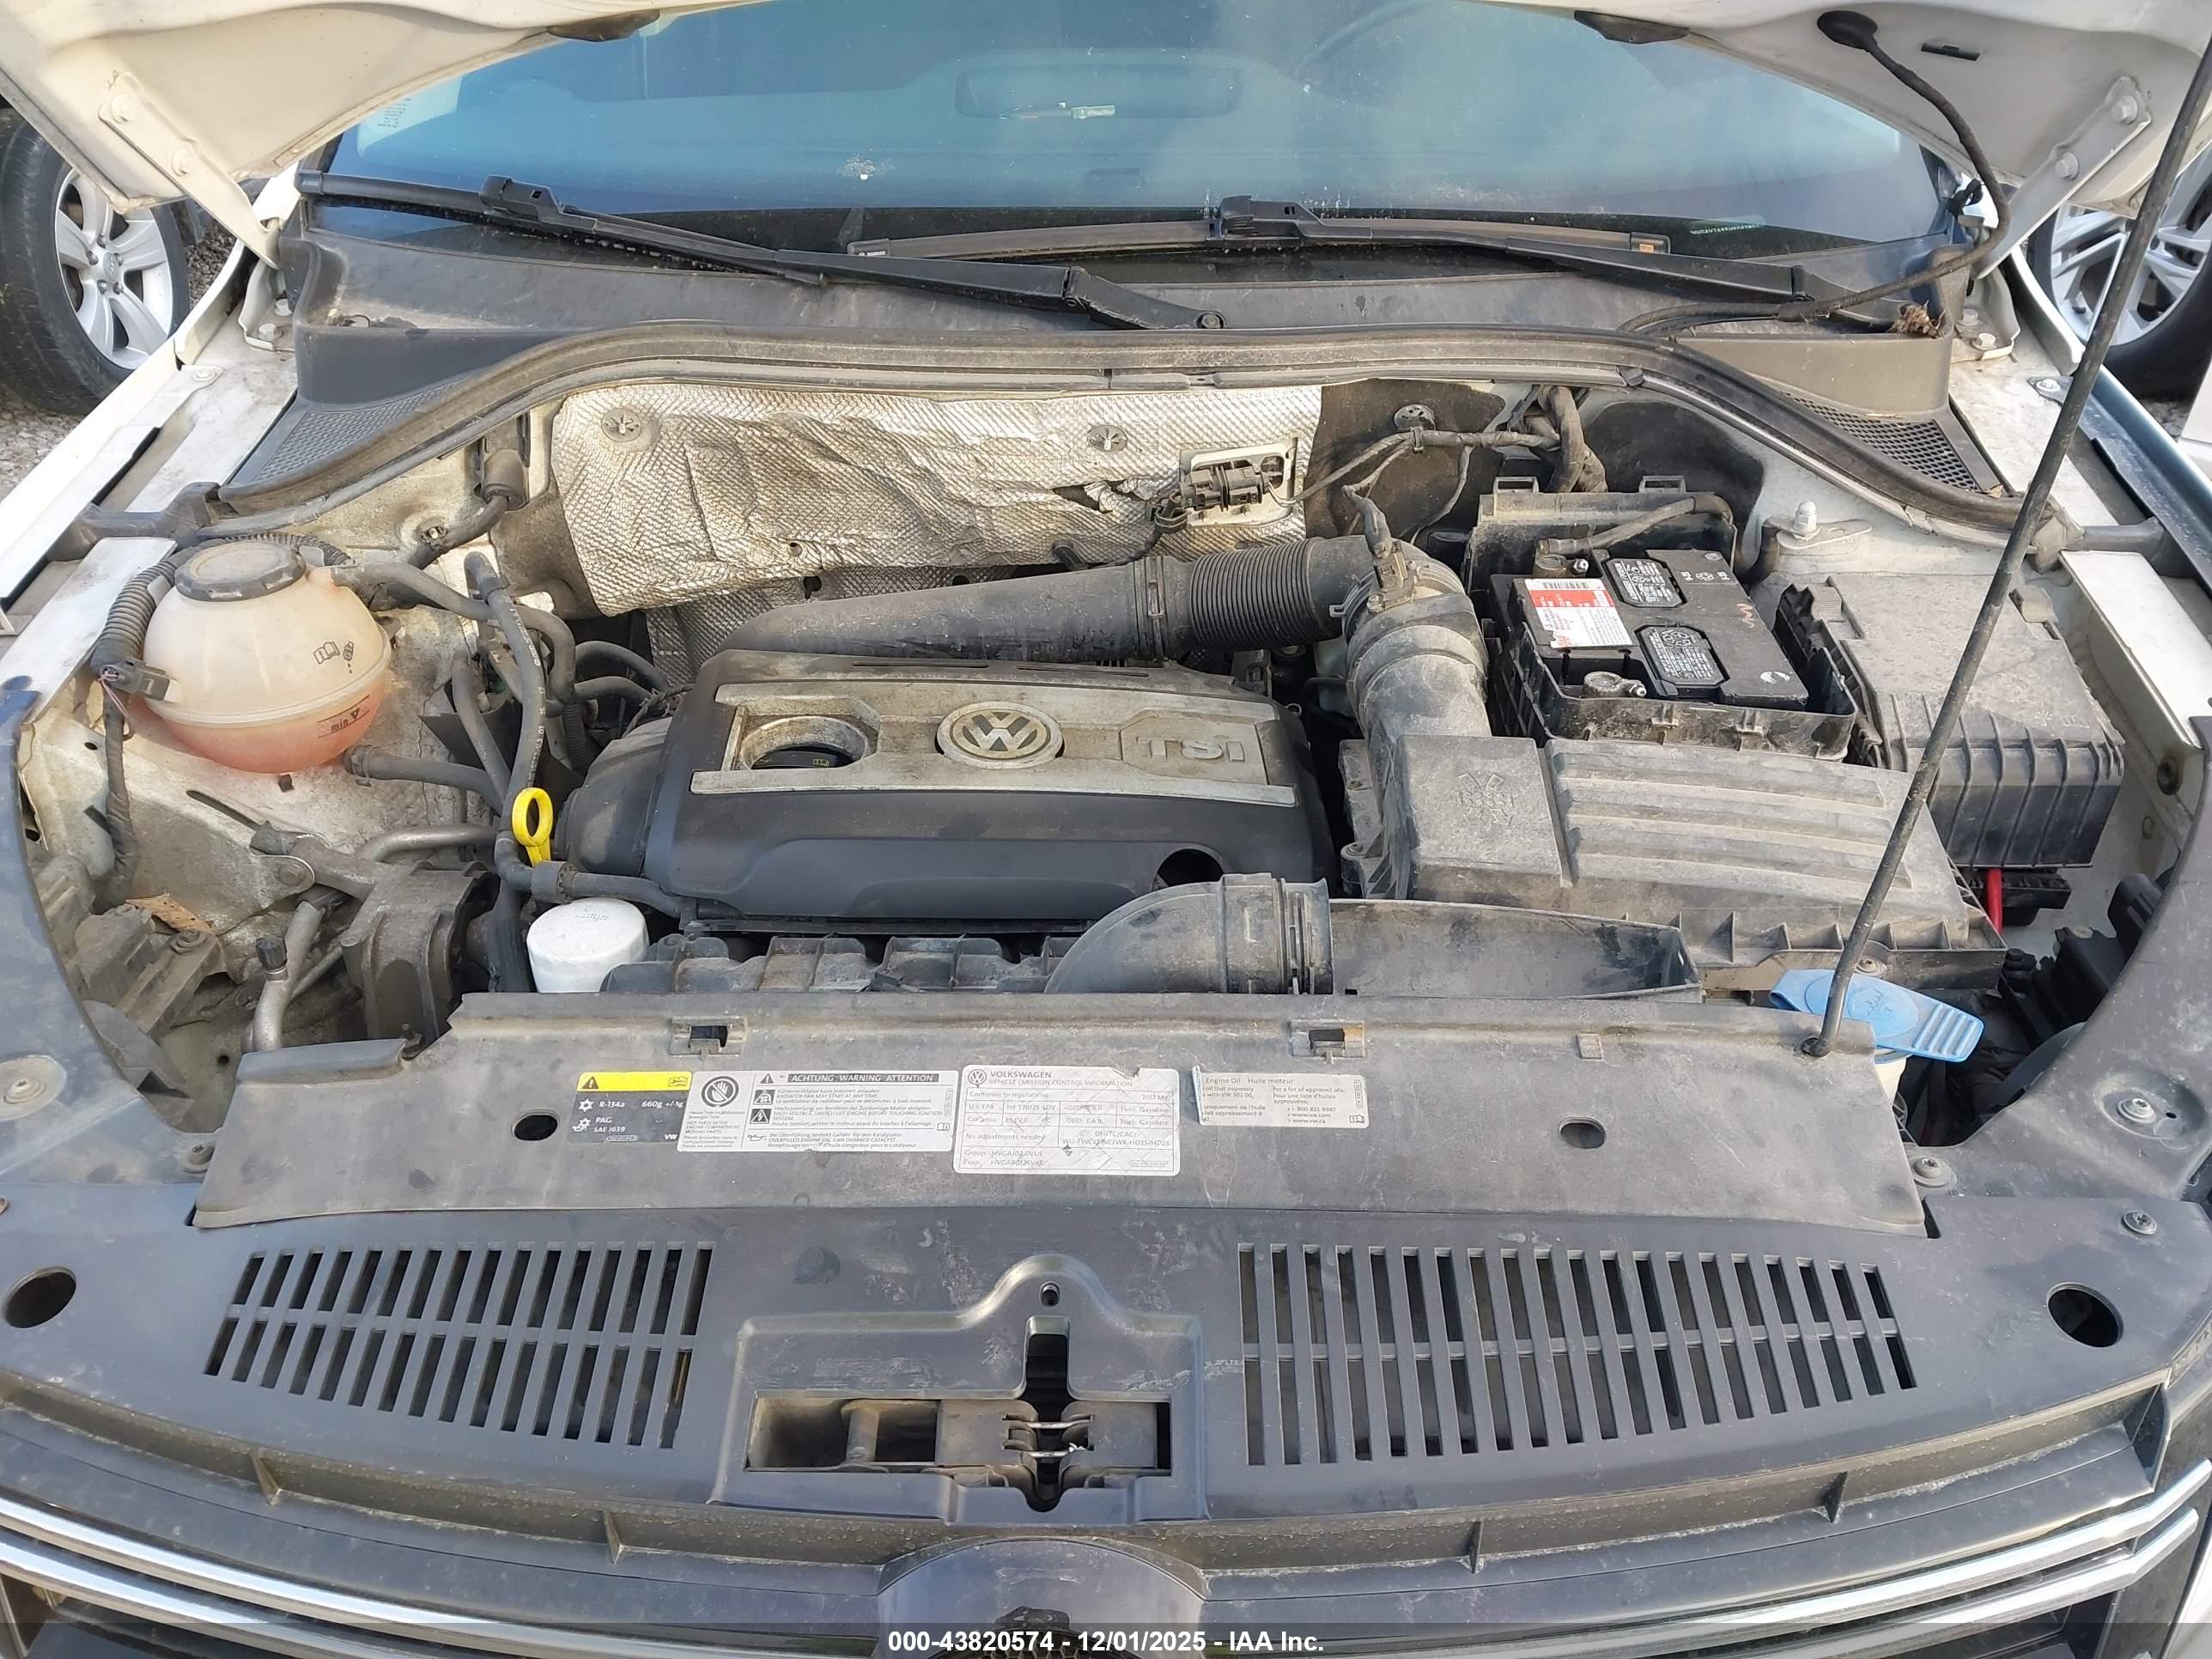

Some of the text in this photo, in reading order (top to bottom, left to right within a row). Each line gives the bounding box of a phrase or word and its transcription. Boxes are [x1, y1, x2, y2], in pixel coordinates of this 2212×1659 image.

[331, 719, 349, 732] min
[1139, 734, 1244, 764] TSI
[641, 1101, 663, 1109] 660g
